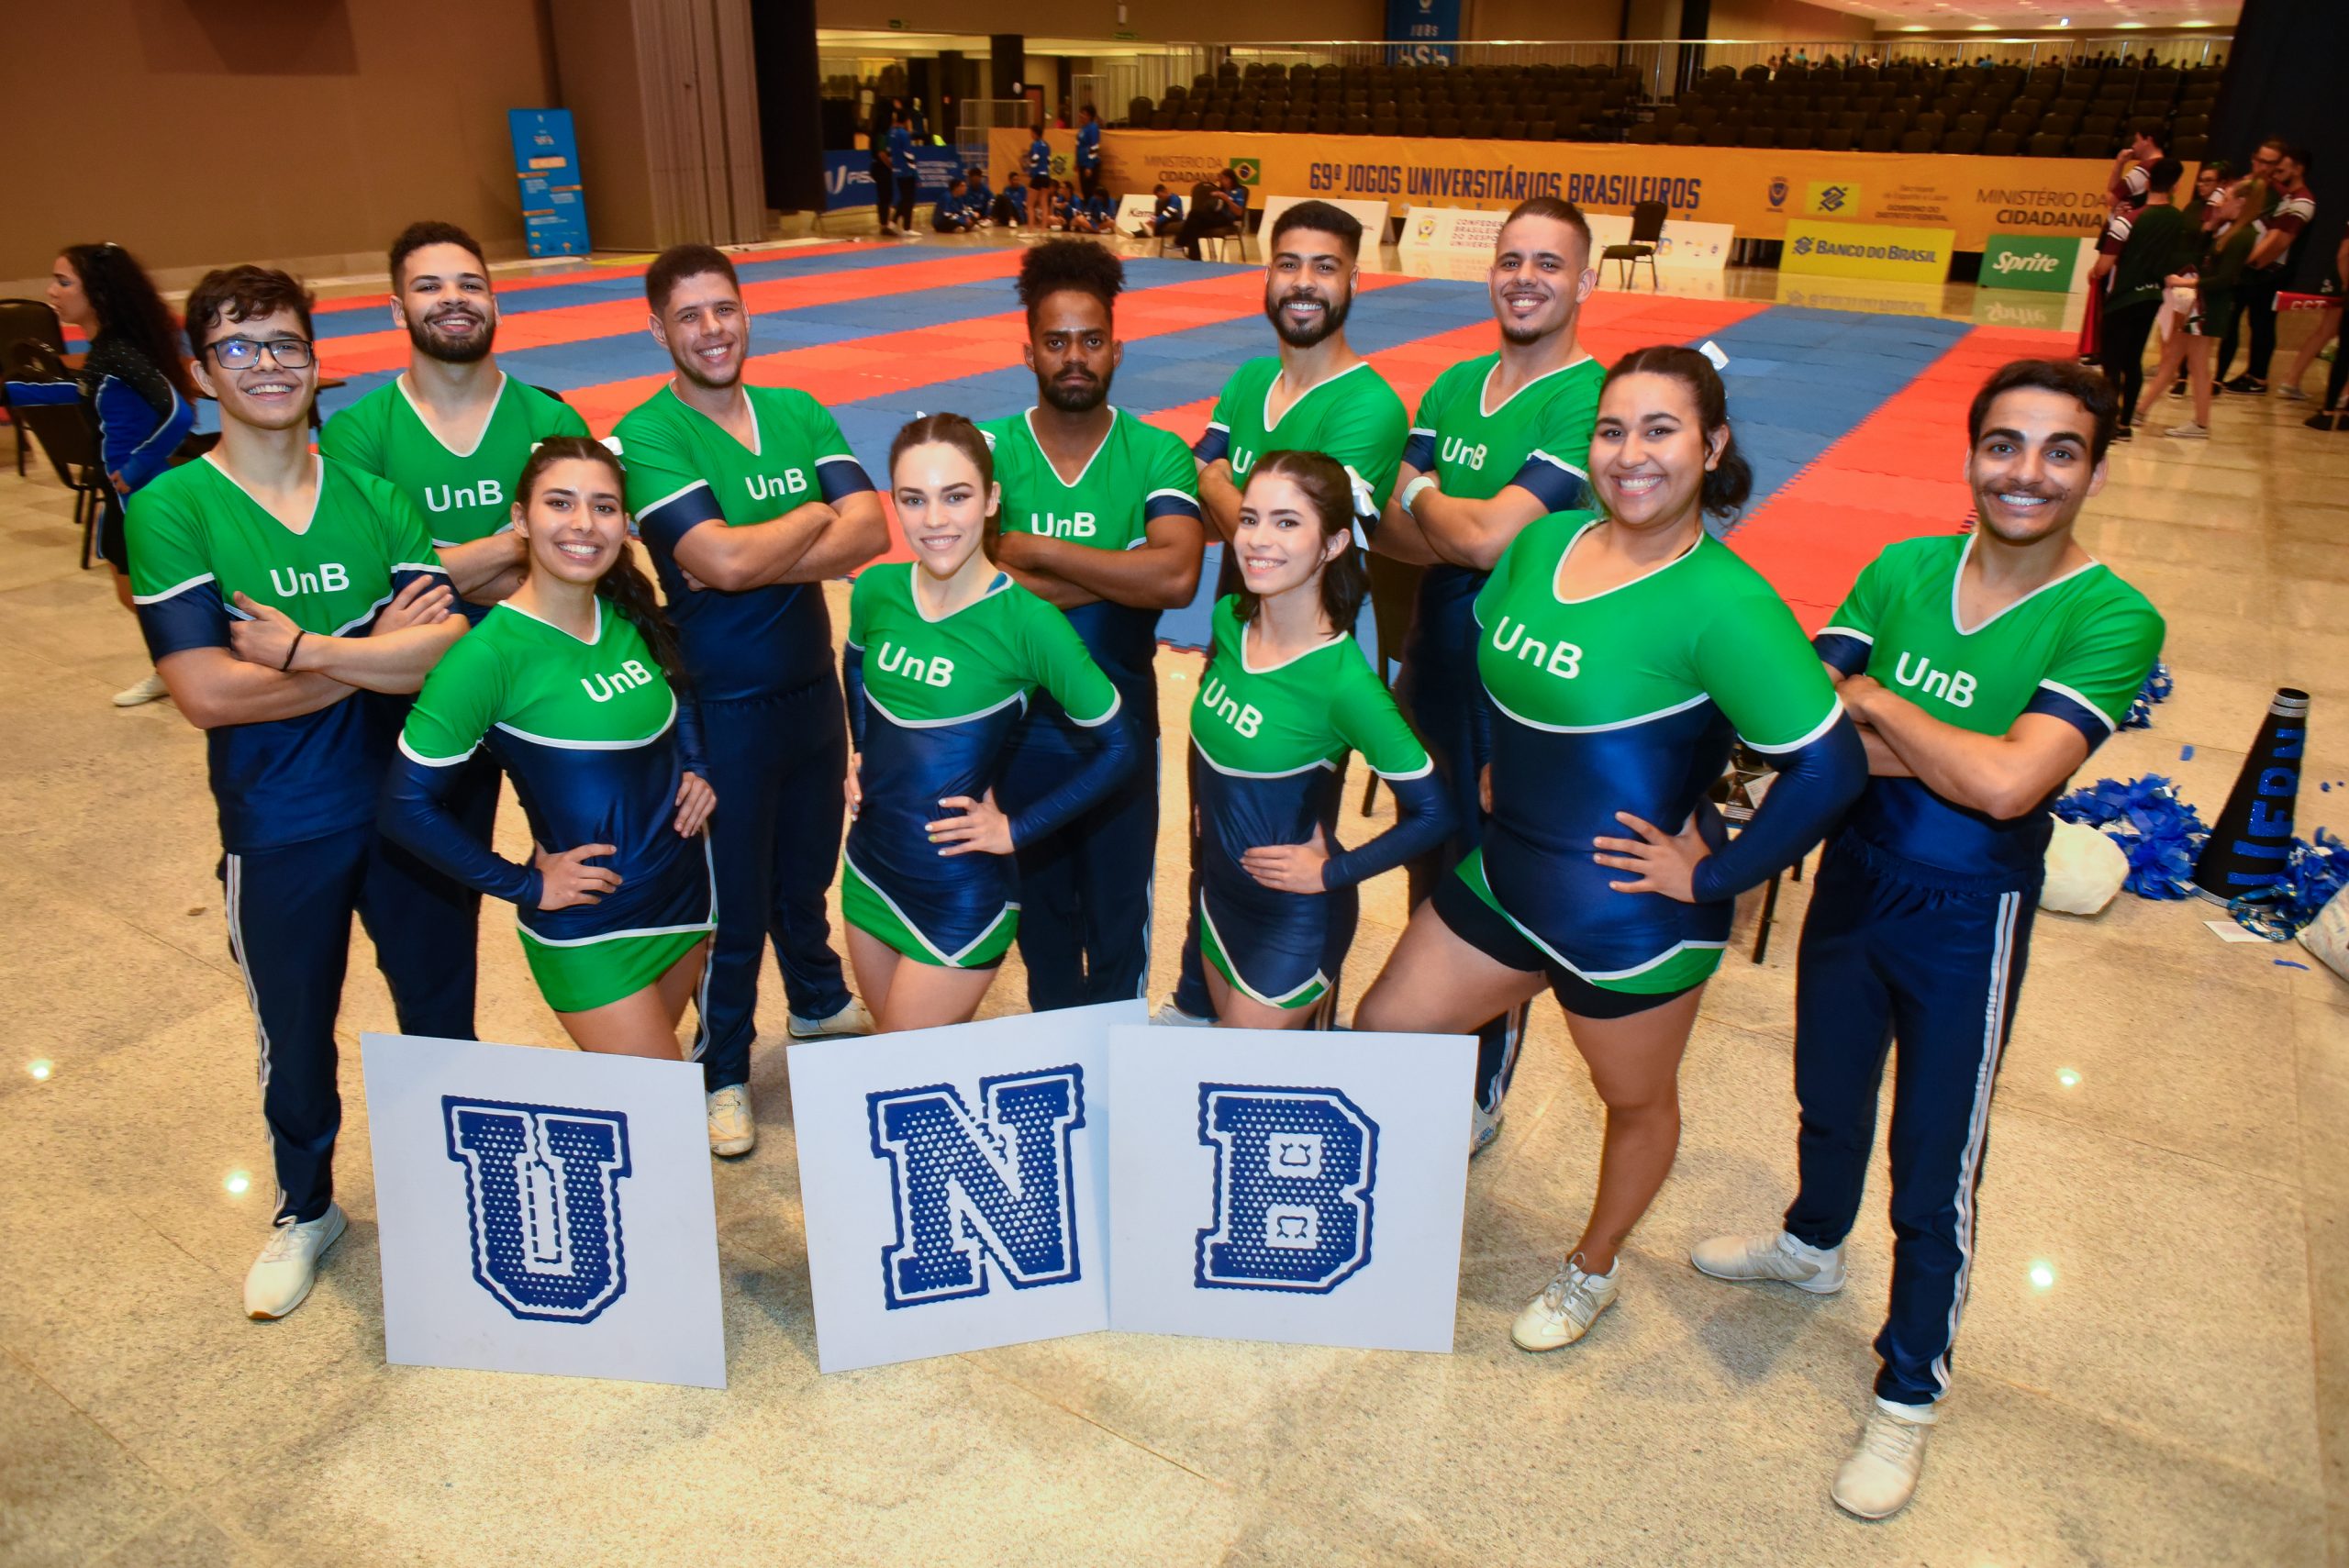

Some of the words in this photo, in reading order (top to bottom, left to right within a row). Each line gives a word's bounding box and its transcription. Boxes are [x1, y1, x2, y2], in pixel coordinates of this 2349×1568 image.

[1344, 164, 1402, 195] JOGOS
[1408, 164, 1562, 201] UNIVERSITÁRIOS
[1567, 172, 1701, 209] BRASILEIROS
[1976, 187, 2077, 207] MINISTÉRIO
[2081, 193, 2108, 208] DA
[1997, 209, 2104, 228] CIDADANIA
[1816, 239, 1864, 258] BANCO
[1866, 245, 1885, 260] DO
[1887, 245, 1936, 263] BRASIL
[1992, 250, 2060, 274] Sprite
[1232, 446, 1256, 477] U
[1442, 436, 1487, 471] UnB
[425, 479, 504, 513] UnB
[744, 468, 807, 501] UnB
[1031, 511, 1097, 538] UnB
[270, 562, 350, 597] UnB
[877, 641, 954, 688] UnB
[1492, 616, 1584, 680] UnB
[581, 659, 652, 704] UnB
[1895, 651, 1978, 708] UnB
[1202, 676, 1264, 740] UnB
[865, 1062, 1086, 1311] N
[1194, 1081, 1380, 1295] B
[440, 1095, 632, 1325] U
